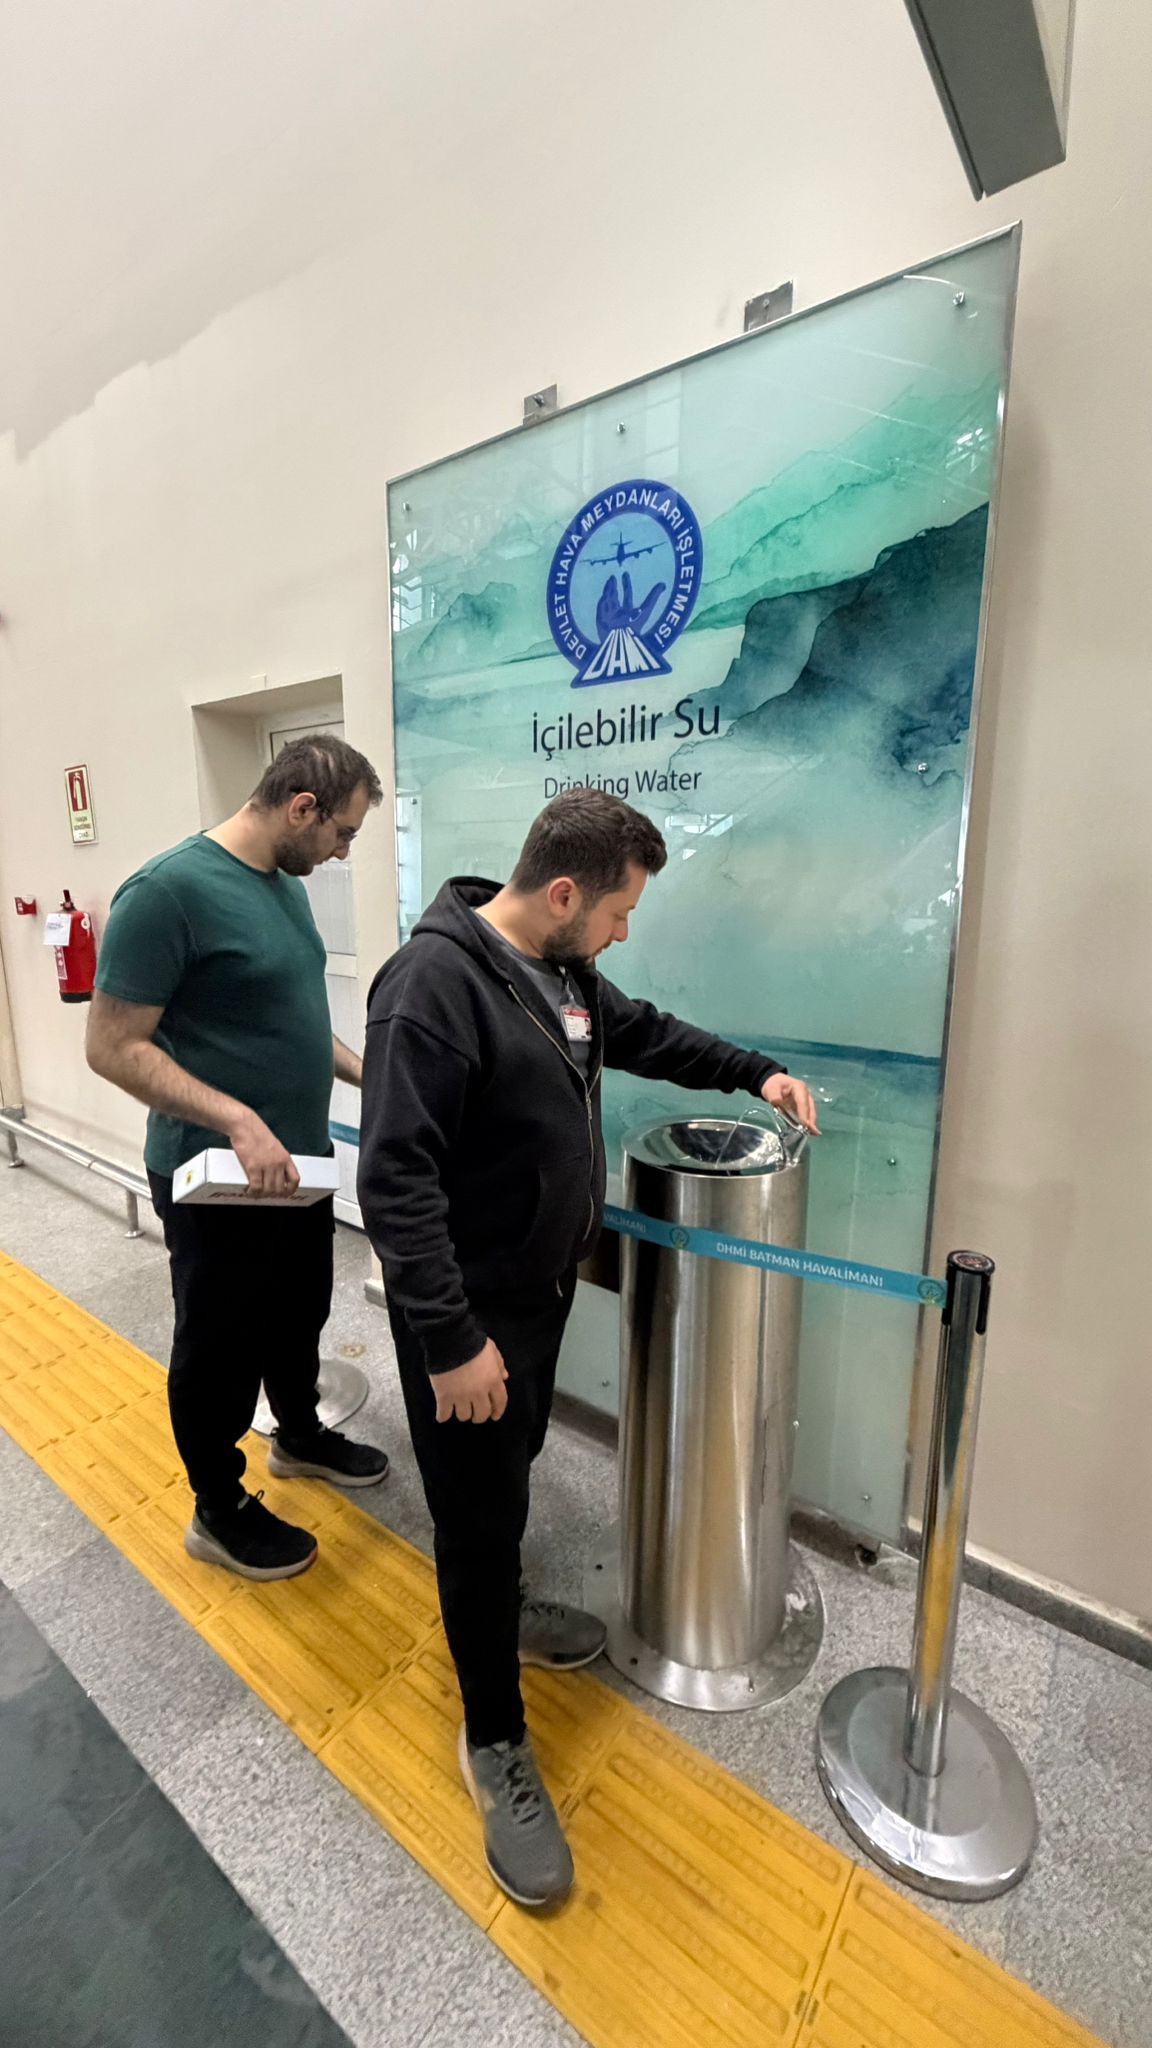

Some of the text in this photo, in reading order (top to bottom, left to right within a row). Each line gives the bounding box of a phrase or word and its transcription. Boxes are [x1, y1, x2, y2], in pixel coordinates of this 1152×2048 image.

[554, 488, 695, 660] DEVLET HAVA MEYDANLARI İŞLETMESİ
[533, 698, 720, 761] İçilebilir Su
[544, 769, 702, 800] Drinking Water
[716, 1242, 884, 1288] DHMİ BATMAN HAVALİMANI
